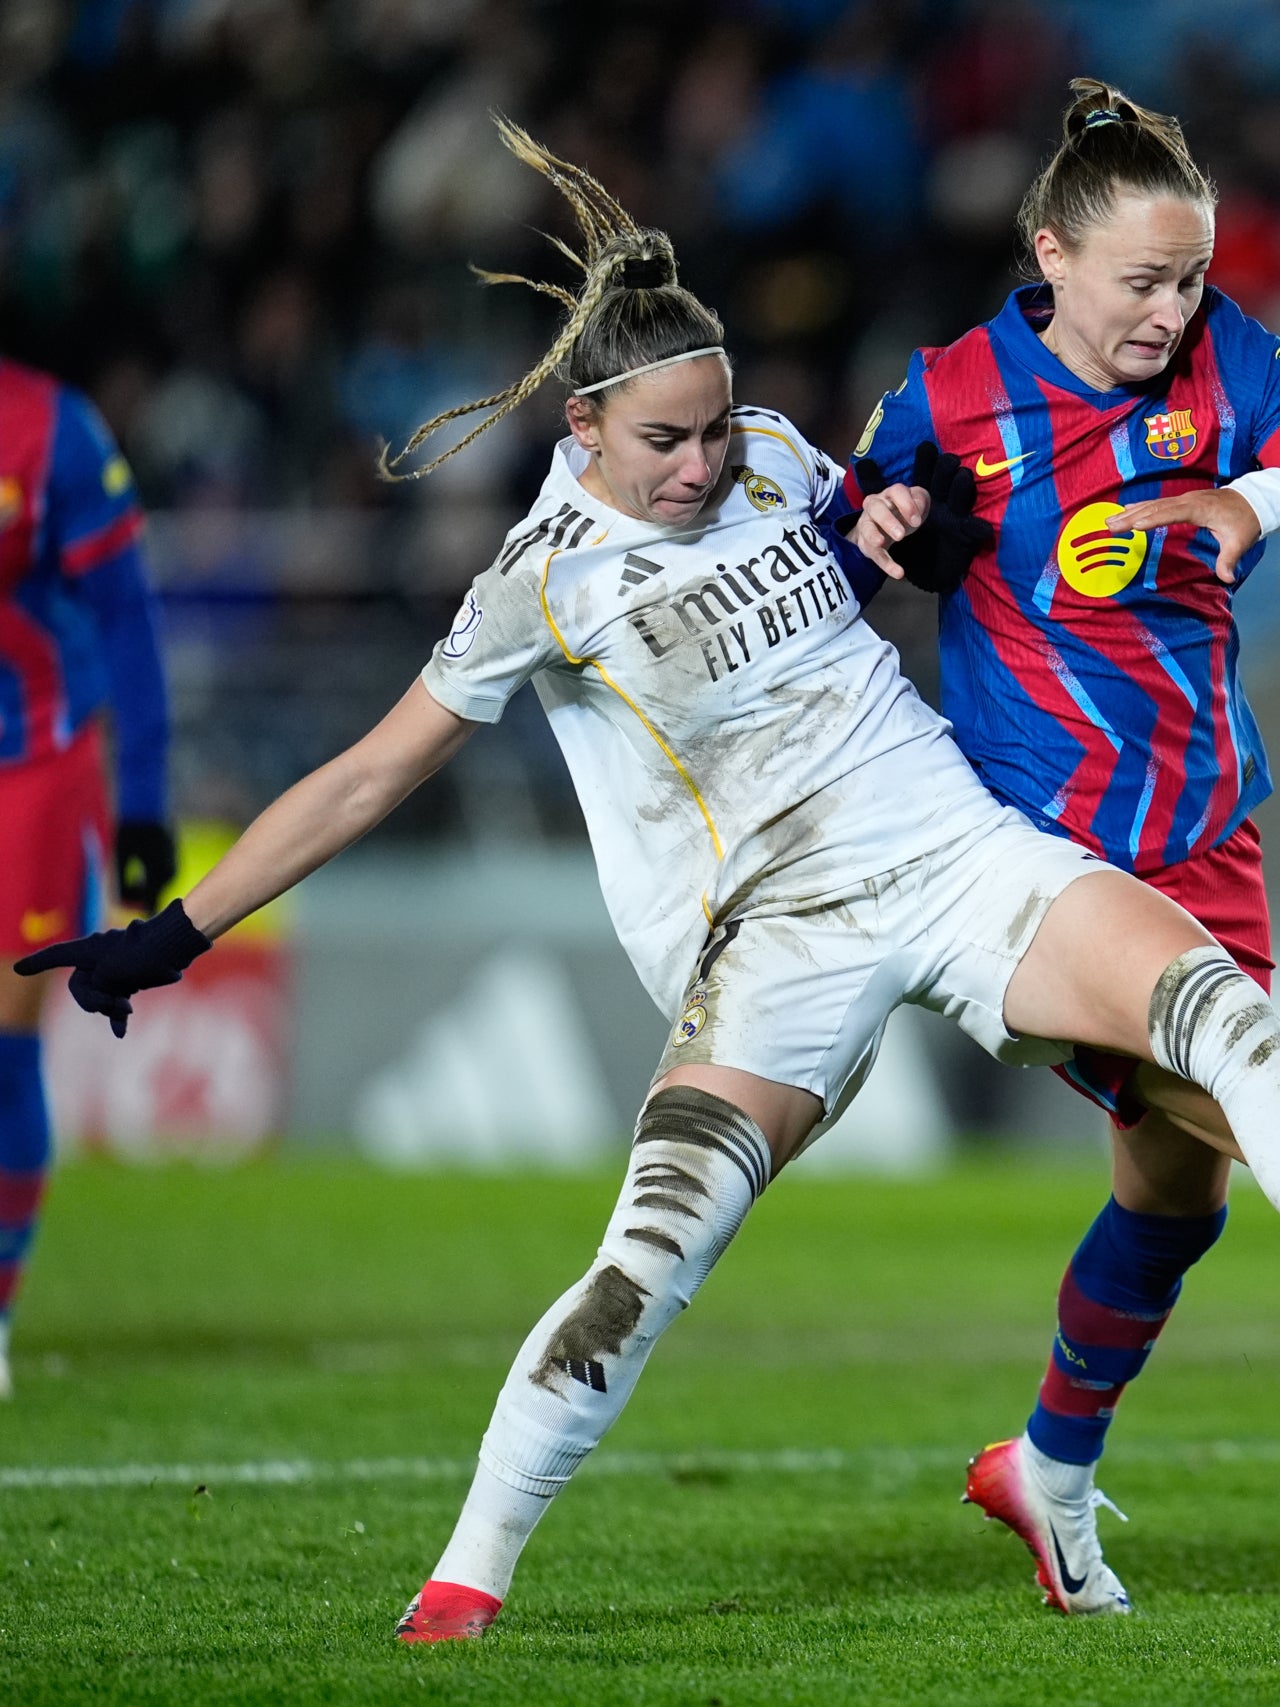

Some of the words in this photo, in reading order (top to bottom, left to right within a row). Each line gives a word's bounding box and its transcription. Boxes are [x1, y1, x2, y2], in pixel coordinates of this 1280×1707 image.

[627, 519, 829, 658] Emirate
[700, 621, 751, 683] FLY
[756, 564, 849, 649] BETTER
